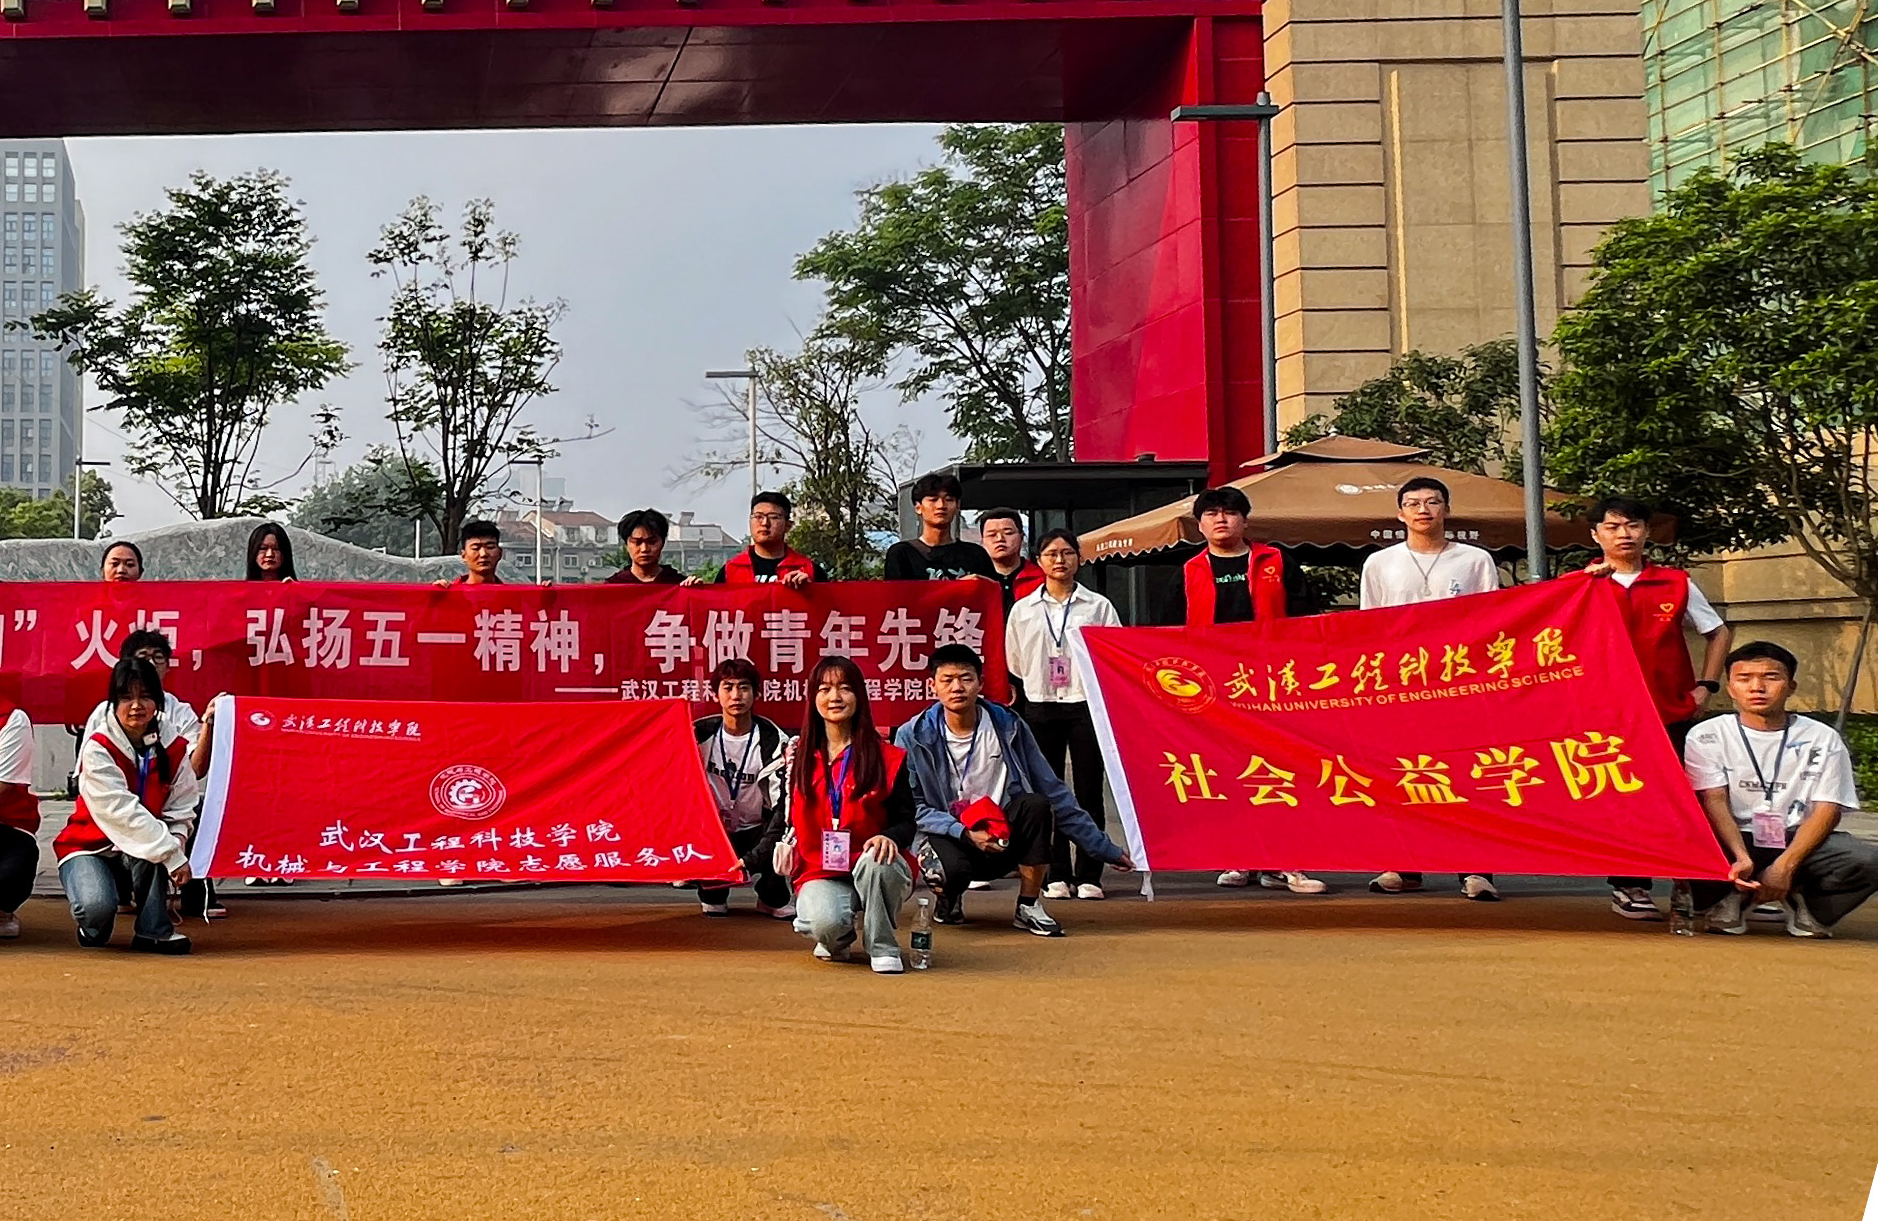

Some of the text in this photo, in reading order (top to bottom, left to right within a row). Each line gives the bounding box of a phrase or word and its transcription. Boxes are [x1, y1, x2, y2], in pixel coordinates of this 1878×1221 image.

[1283, 696, 1373, 712] UNIVERSITY
[1376, 693, 1396, 705] OF
[1399, 680, 1510, 703] ENGINEERING
[1511, 665, 1585, 688] SCIENCE
[1159, 731, 1644, 808] 社会公益学院
[320, 819, 621, 855] 武汉工程科技学院
[235, 843, 715, 874] 机械与工程学院志愿服务队
